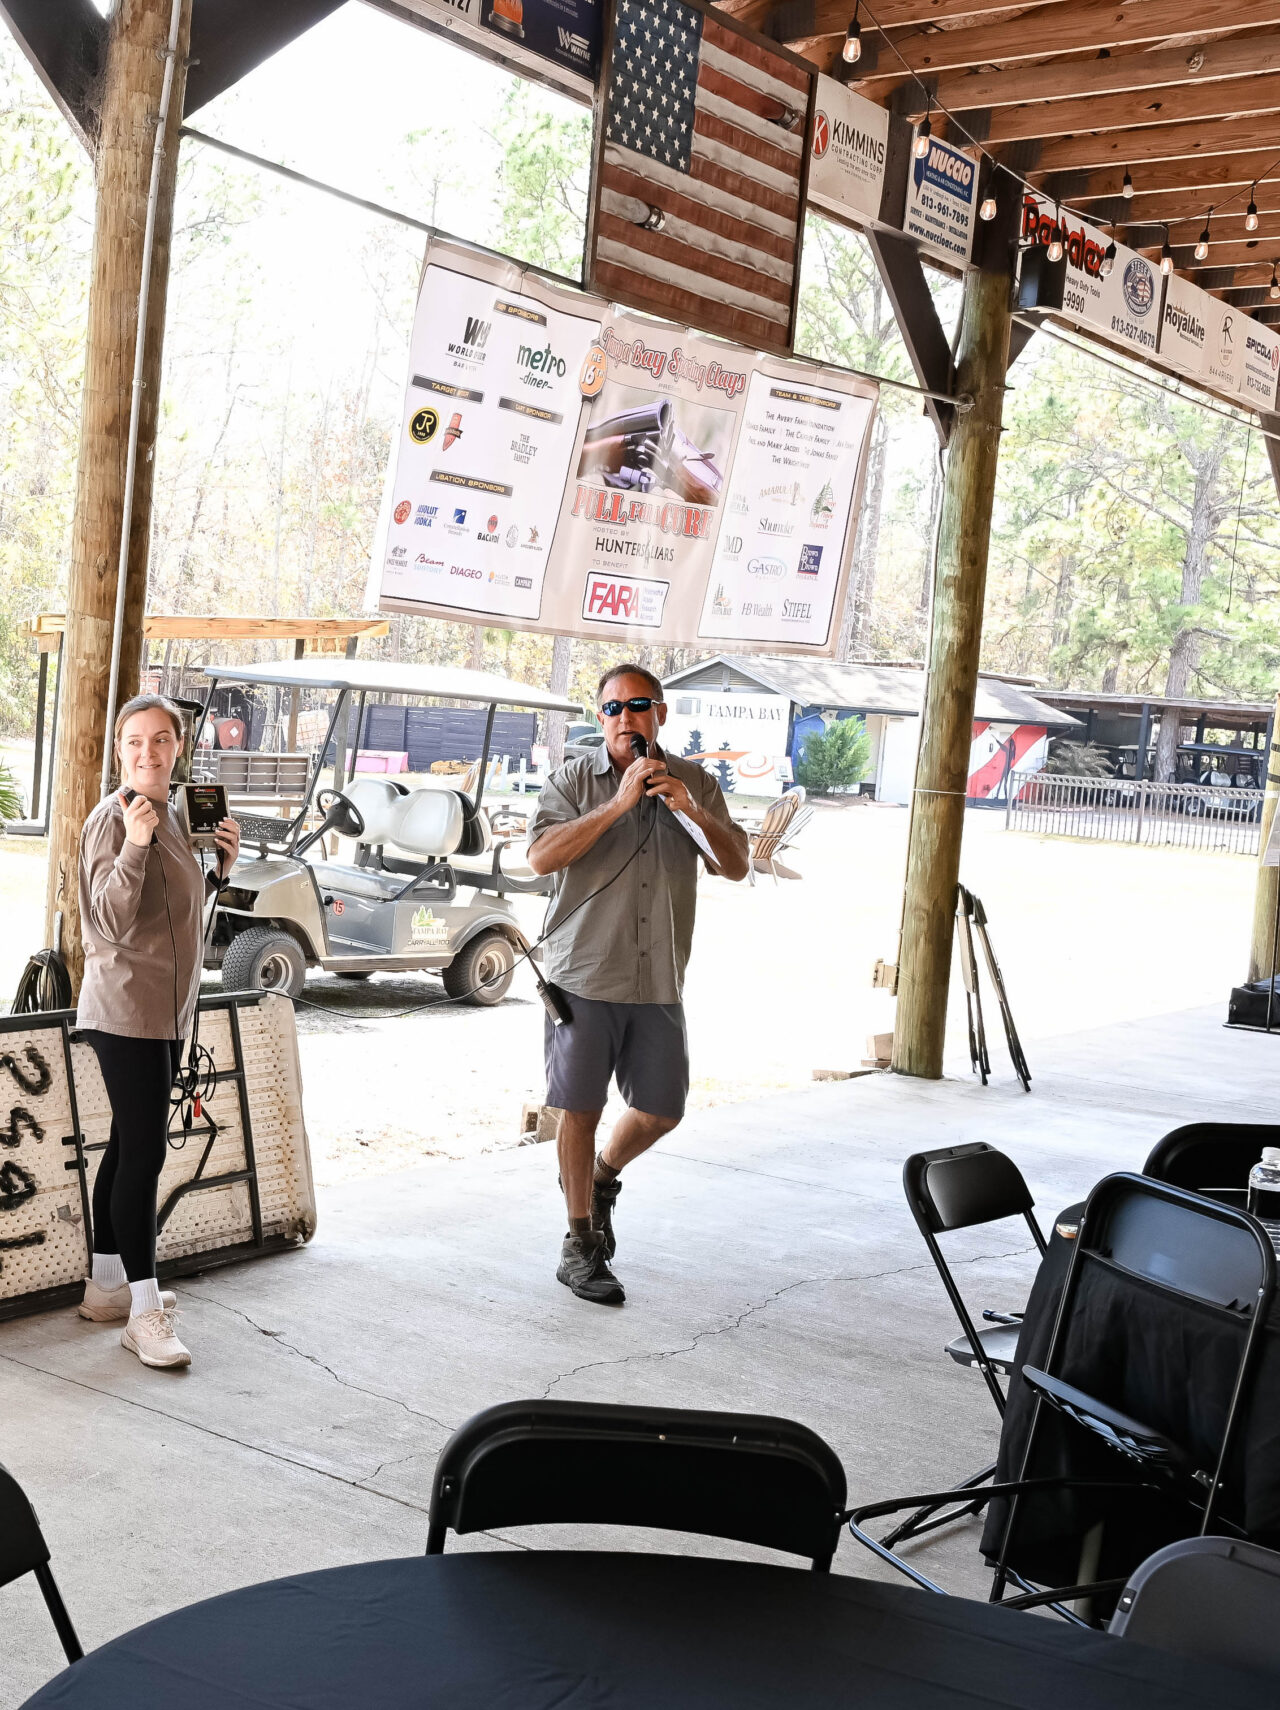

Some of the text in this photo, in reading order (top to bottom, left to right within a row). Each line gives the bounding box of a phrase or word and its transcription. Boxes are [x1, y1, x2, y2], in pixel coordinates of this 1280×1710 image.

[832, 118, 885, 165] KIMMINS
[831, 143, 868, 168] CONTRACTING
[927, 146, 972, 186] NUCCIO
[908, 220, 967, 257] www.nuccioac.com
[1079, 280, 1090, 295] Duty
[1165, 303, 1205, 342] RoyalAire
[1111, 315, 1155, 349] 813-527-0679
[1245, 336, 1272, 360] SPICOLA
[517, 342, 566, 378] metro
[631, 339, 668, 378] Bay
[705, 360, 747, 399] Clays
[775, 390, 791, 399] TEAM
[766, 410, 775, 421] THE
[520, 433, 531, 444] THE
[785, 428, 795, 438] THE
[510, 440, 538, 457] BRADLEY
[766, 440, 783, 450] MARY
[772, 454, 781, 465] THE
[593, 526, 630, 537] HOSTED BY
[414, 553, 446, 567] Beam
[592, 558, 629, 569] TO BENEFIT
[747, 558, 783, 578] GASTRO
[449, 565, 483, 580] DIAGEO
[588, 581, 640, 619] FARA
[753, 603, 773, 618] Wealth
[781, 599, 813, 620] STIFEL
[706, 703, 785, 721] TAMPA BAY
[334, 901, 343, 914] 15
